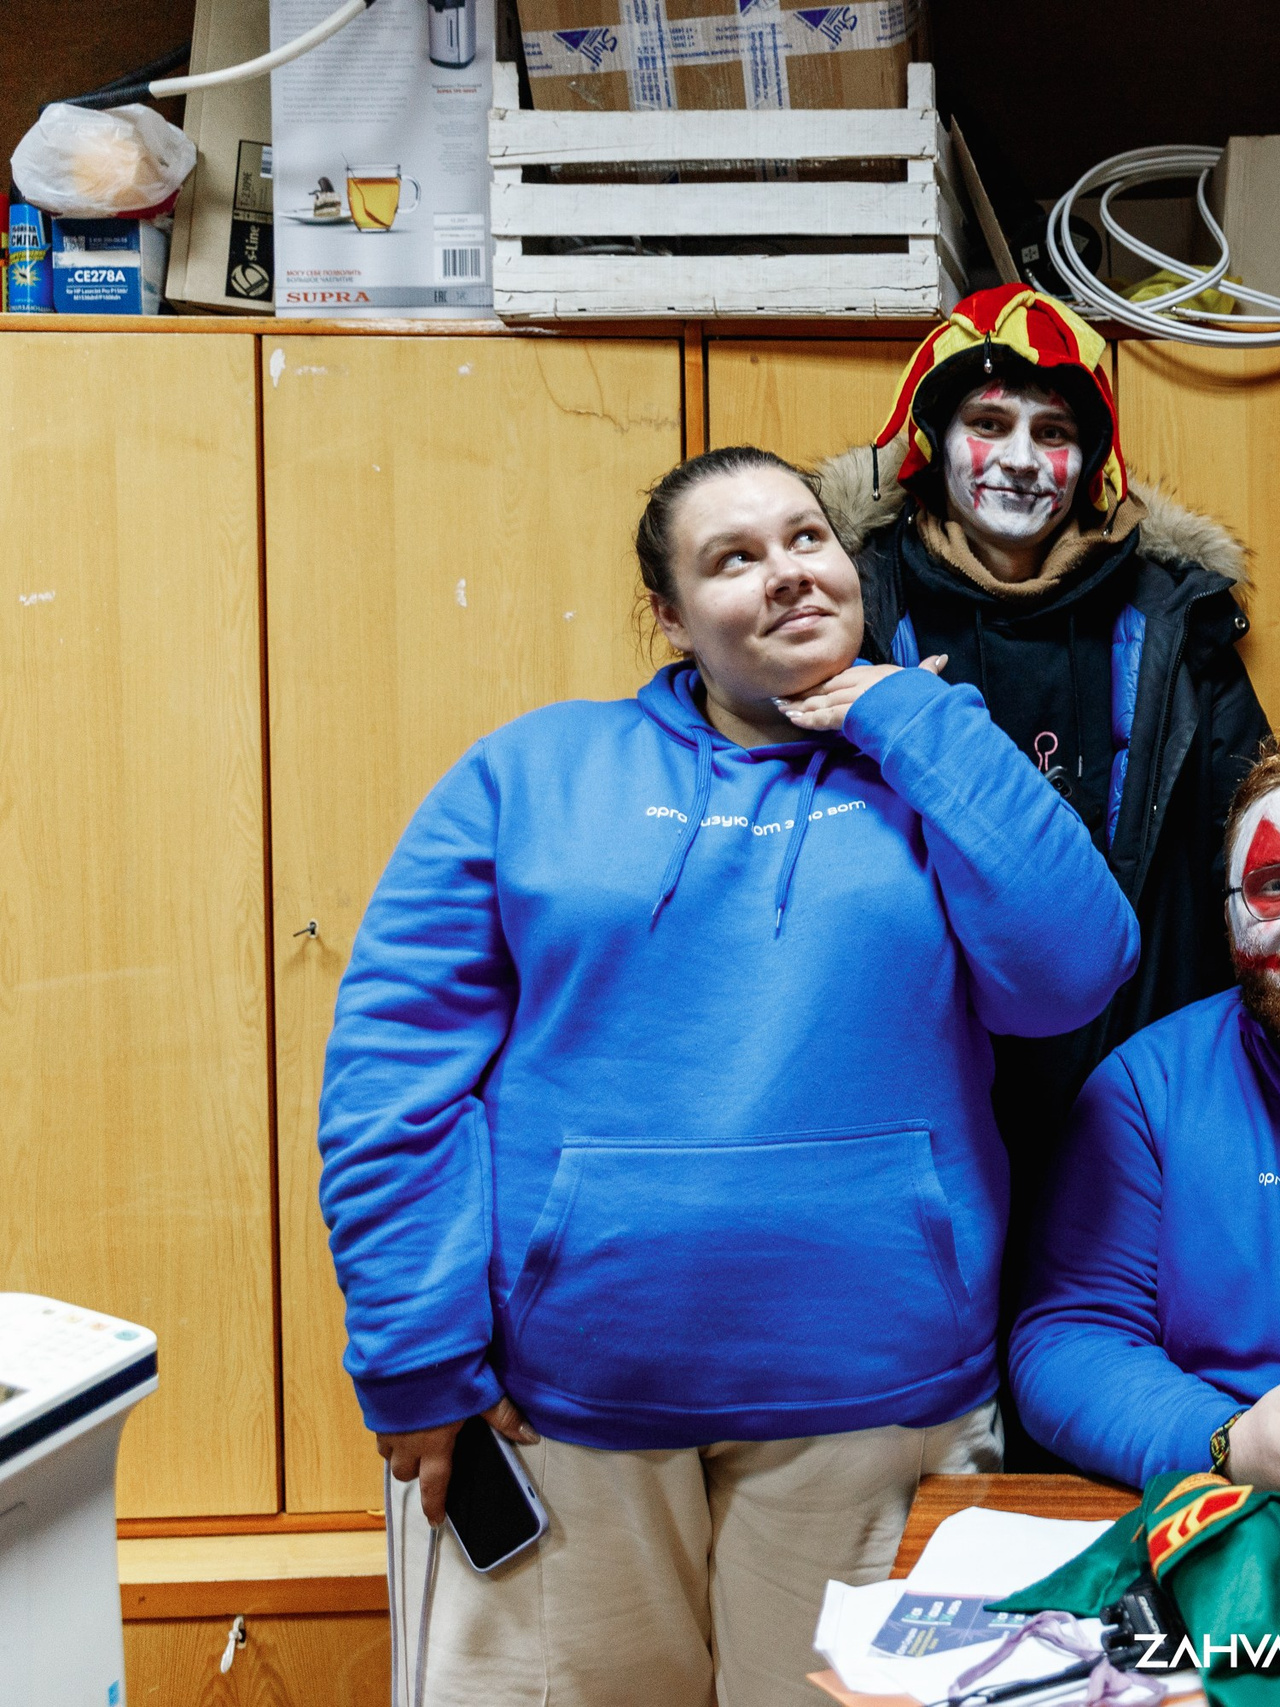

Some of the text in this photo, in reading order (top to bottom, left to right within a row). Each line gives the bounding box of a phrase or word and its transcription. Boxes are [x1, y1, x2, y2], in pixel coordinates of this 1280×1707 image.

[11, 234, 39, 247] СИЛА
[74, 270, 126, 283] CE278A
[286, 291, 371, 303] SUPRA
[646, 806, 748, 828] оргаизую
[751, 820, 781, 836] от
